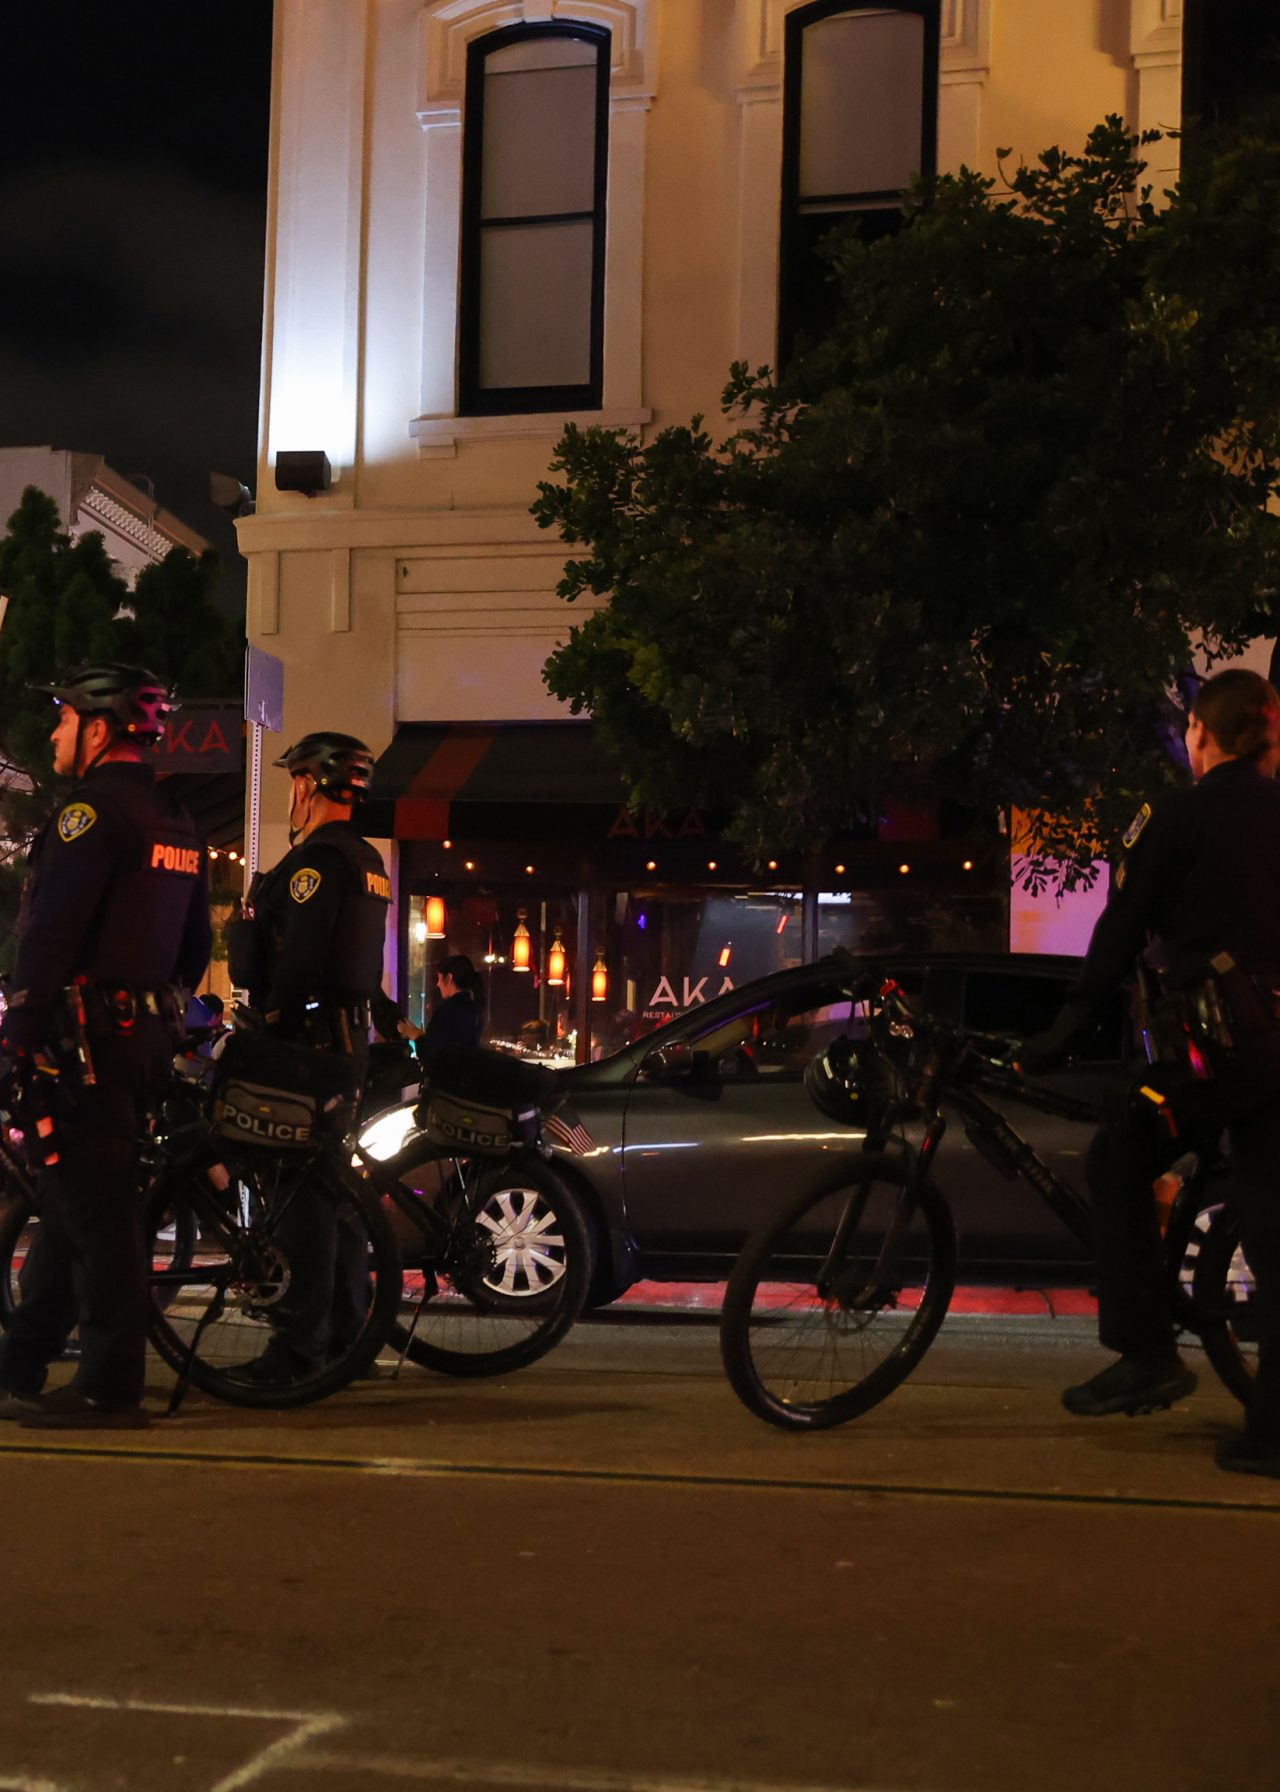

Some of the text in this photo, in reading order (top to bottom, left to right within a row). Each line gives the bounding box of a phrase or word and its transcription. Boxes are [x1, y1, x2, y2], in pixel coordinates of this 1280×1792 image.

[152, 719, 230, 753] KA
[151, 844, 199, 874] POLICE
[223, 1103, 311, 1141] POLICE
